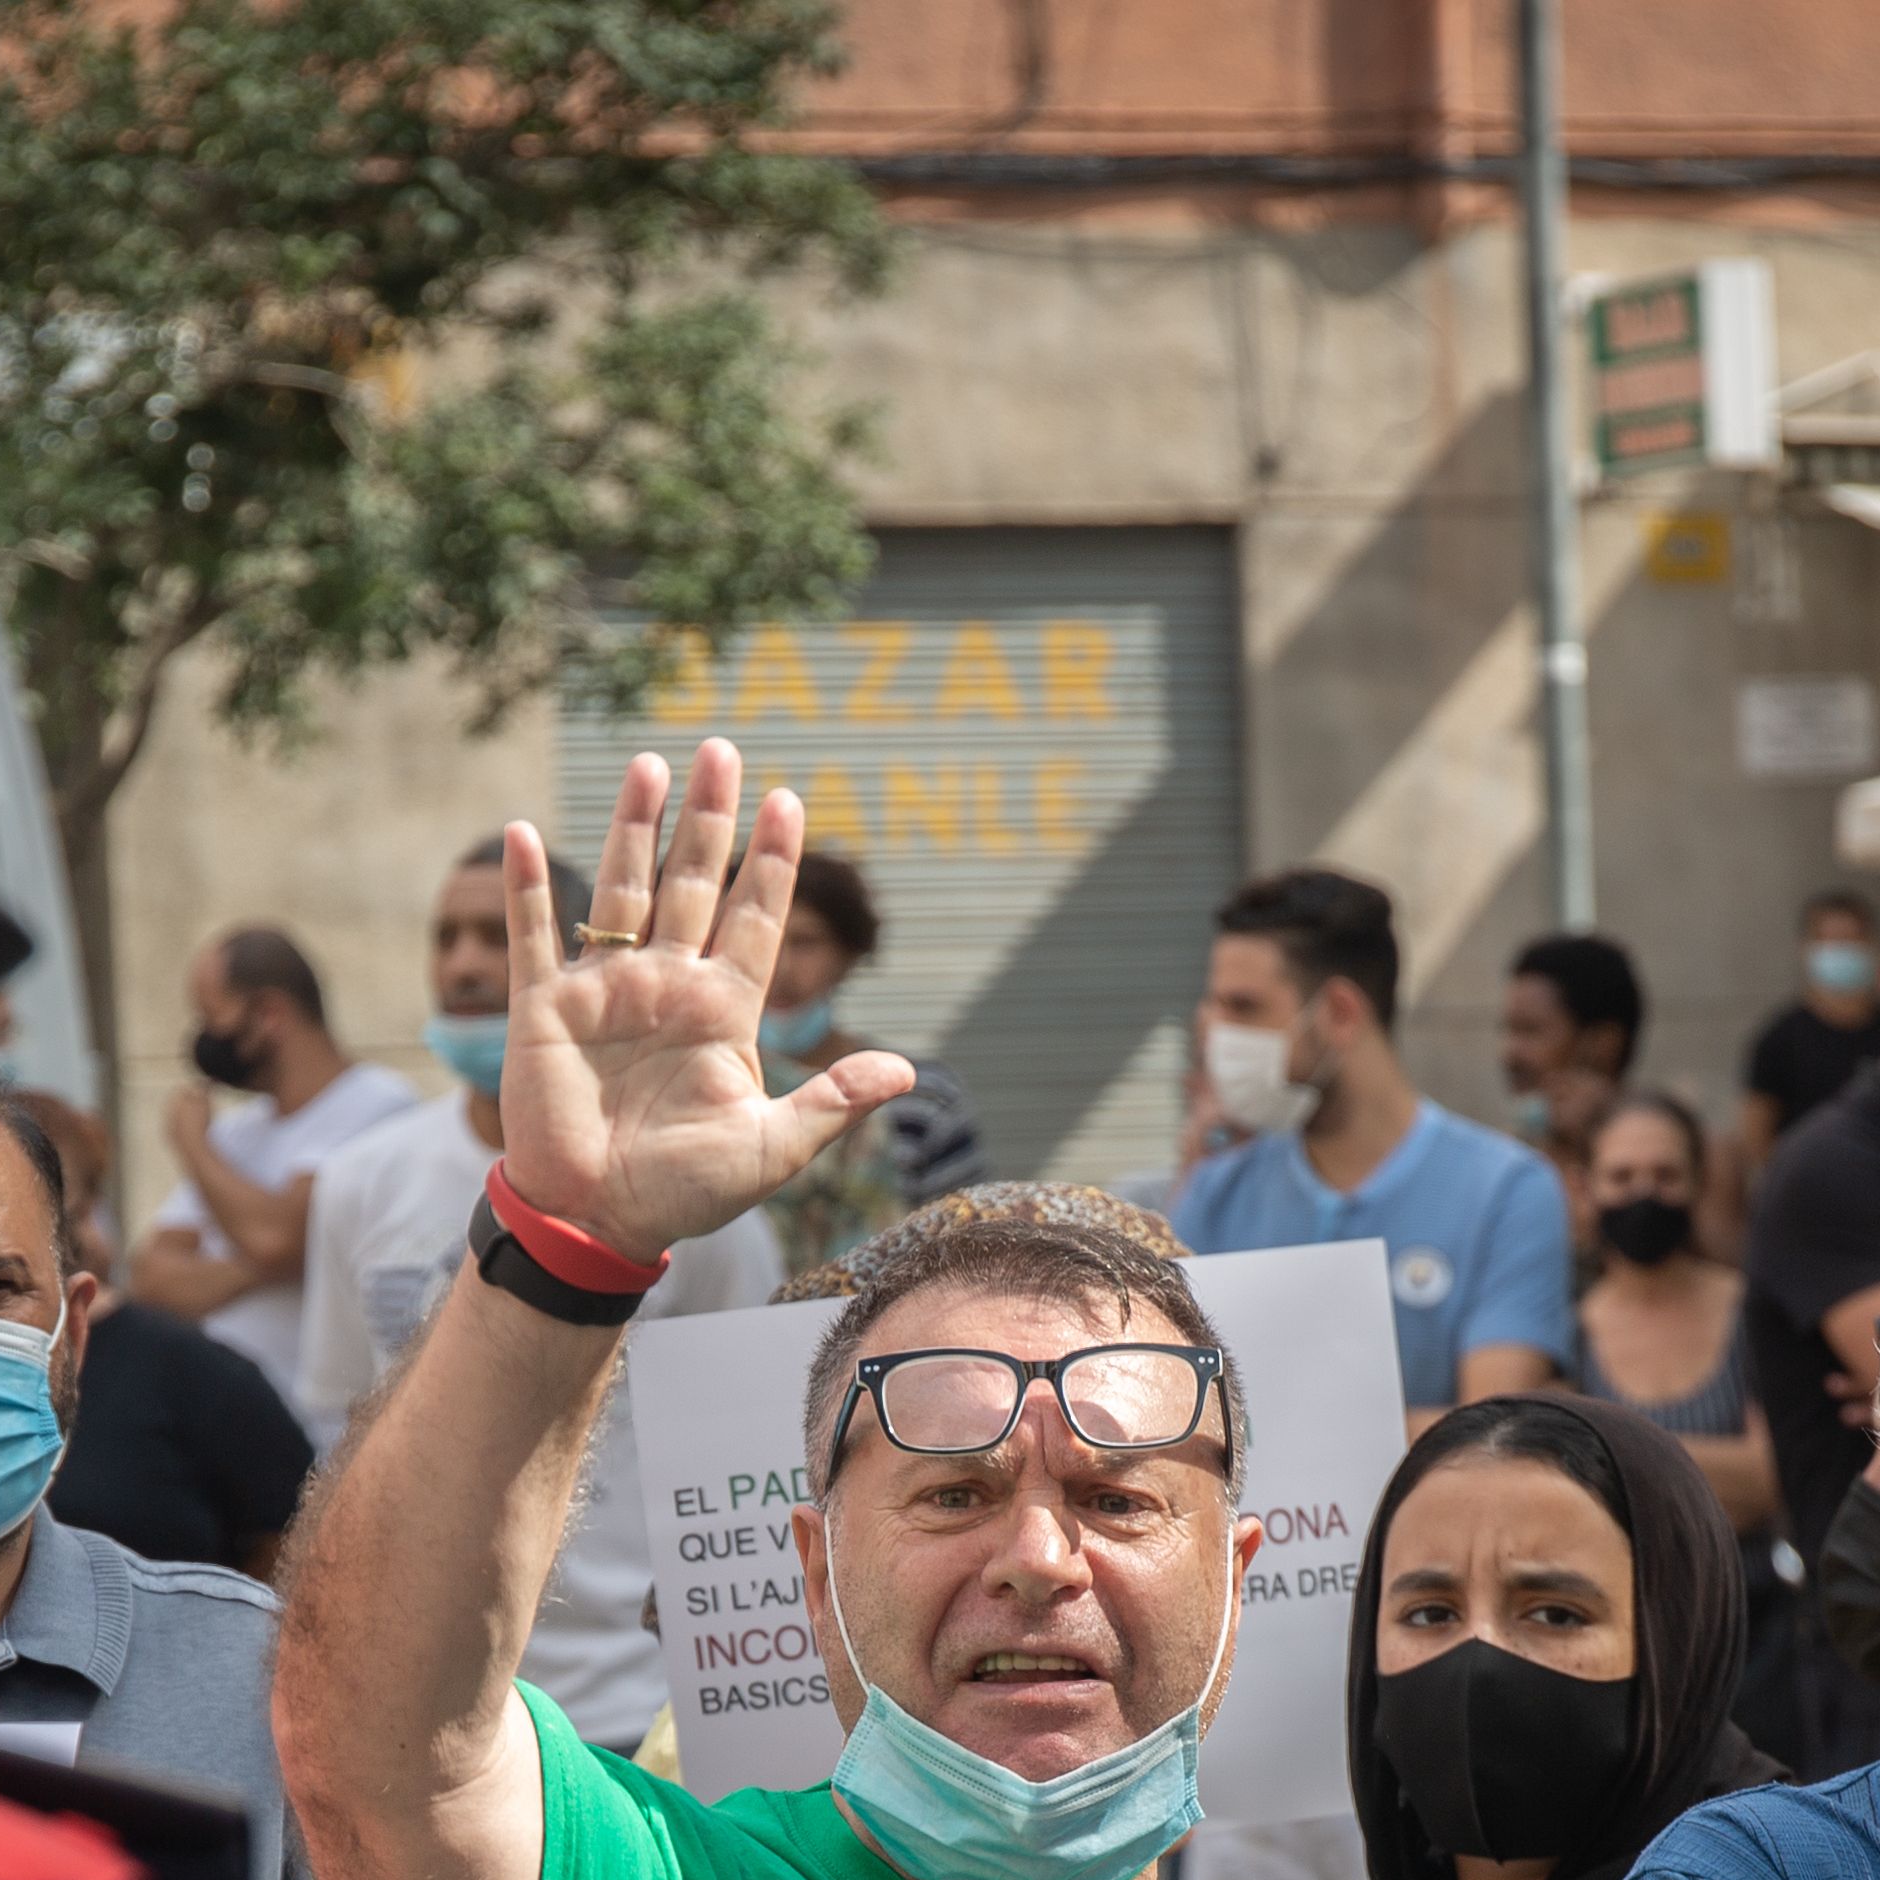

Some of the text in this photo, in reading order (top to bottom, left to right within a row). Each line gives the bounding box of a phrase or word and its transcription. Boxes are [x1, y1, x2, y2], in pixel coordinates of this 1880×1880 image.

[674, 1486, 718, 1518] EL
[679, 1526, 757, 1563] QUE
[686, 1585, 719, 1617] SI
[730, 1574, 808, 1612] L'AJ
[694, 1624, 821, 1672] INCO
[1240, 1572, 1290, 1607] RA
[699, 1674, 830, 1717] BASICS
